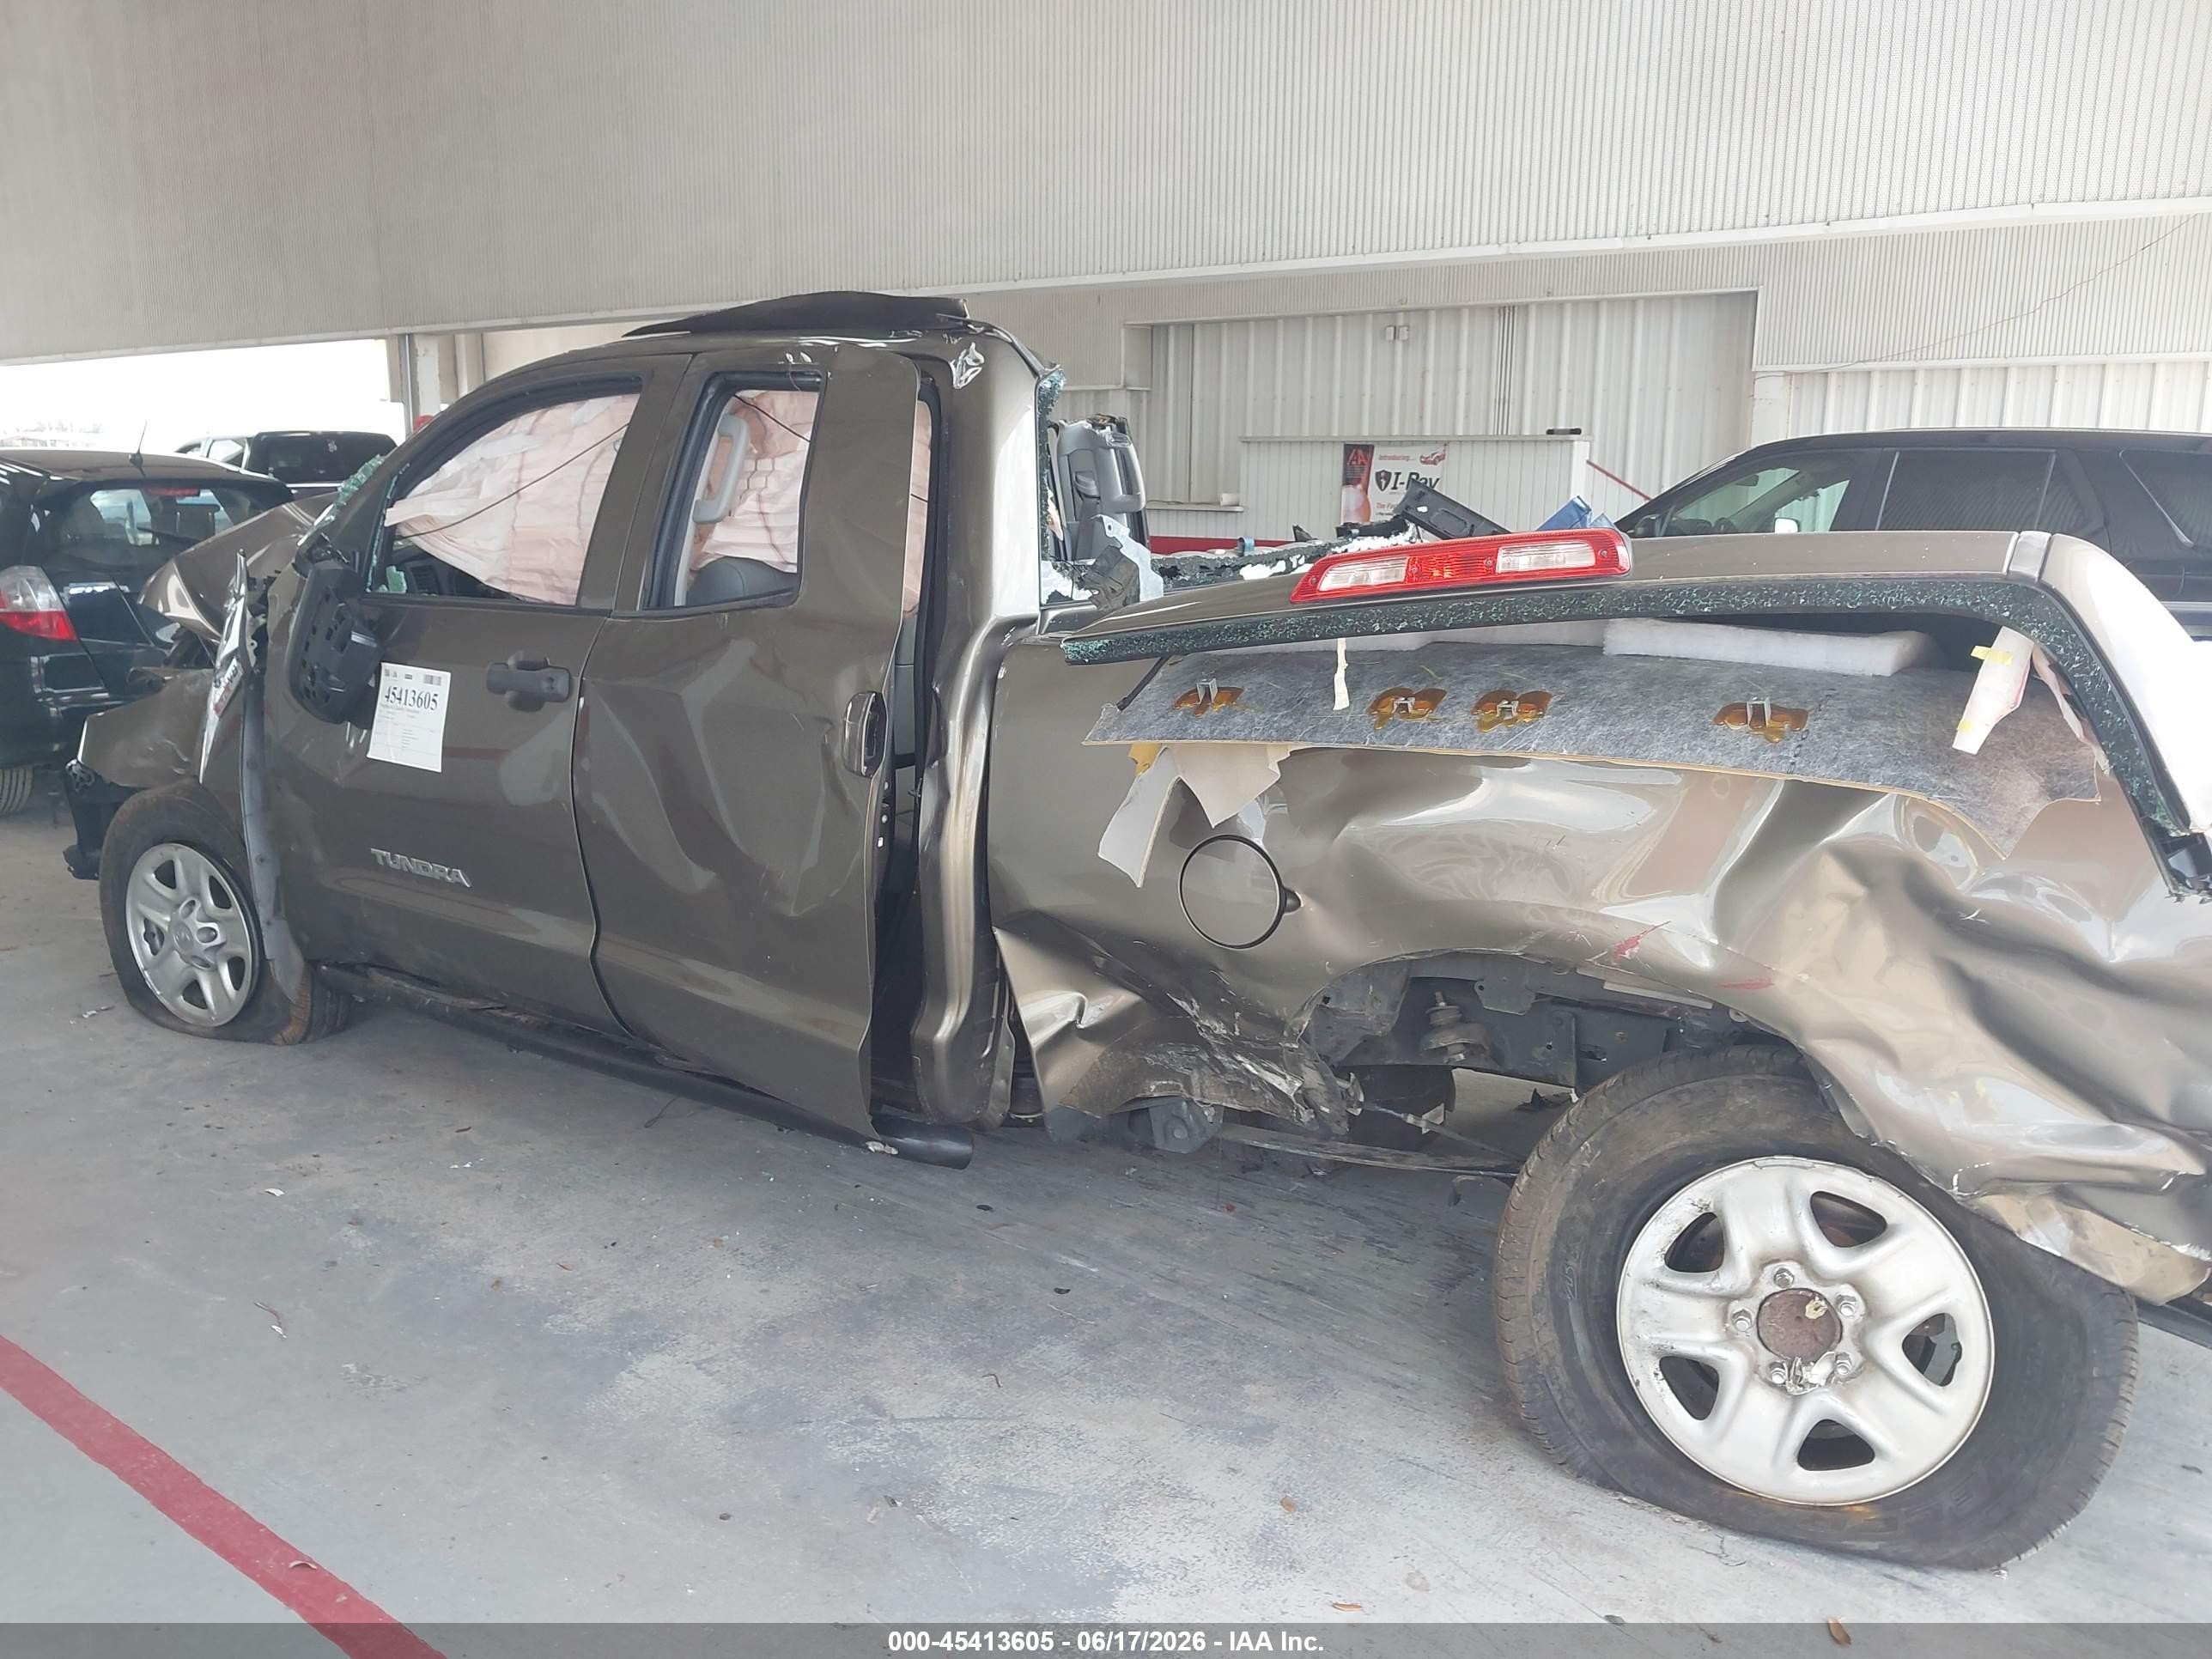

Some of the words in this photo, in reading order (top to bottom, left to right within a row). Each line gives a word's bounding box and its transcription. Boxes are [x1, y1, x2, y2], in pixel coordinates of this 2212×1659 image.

[1391, 471, 1440, 490] I-Pay
[385, 685, 440, 711] 45413605
[370, 847, 471, 888] TUNDRA
